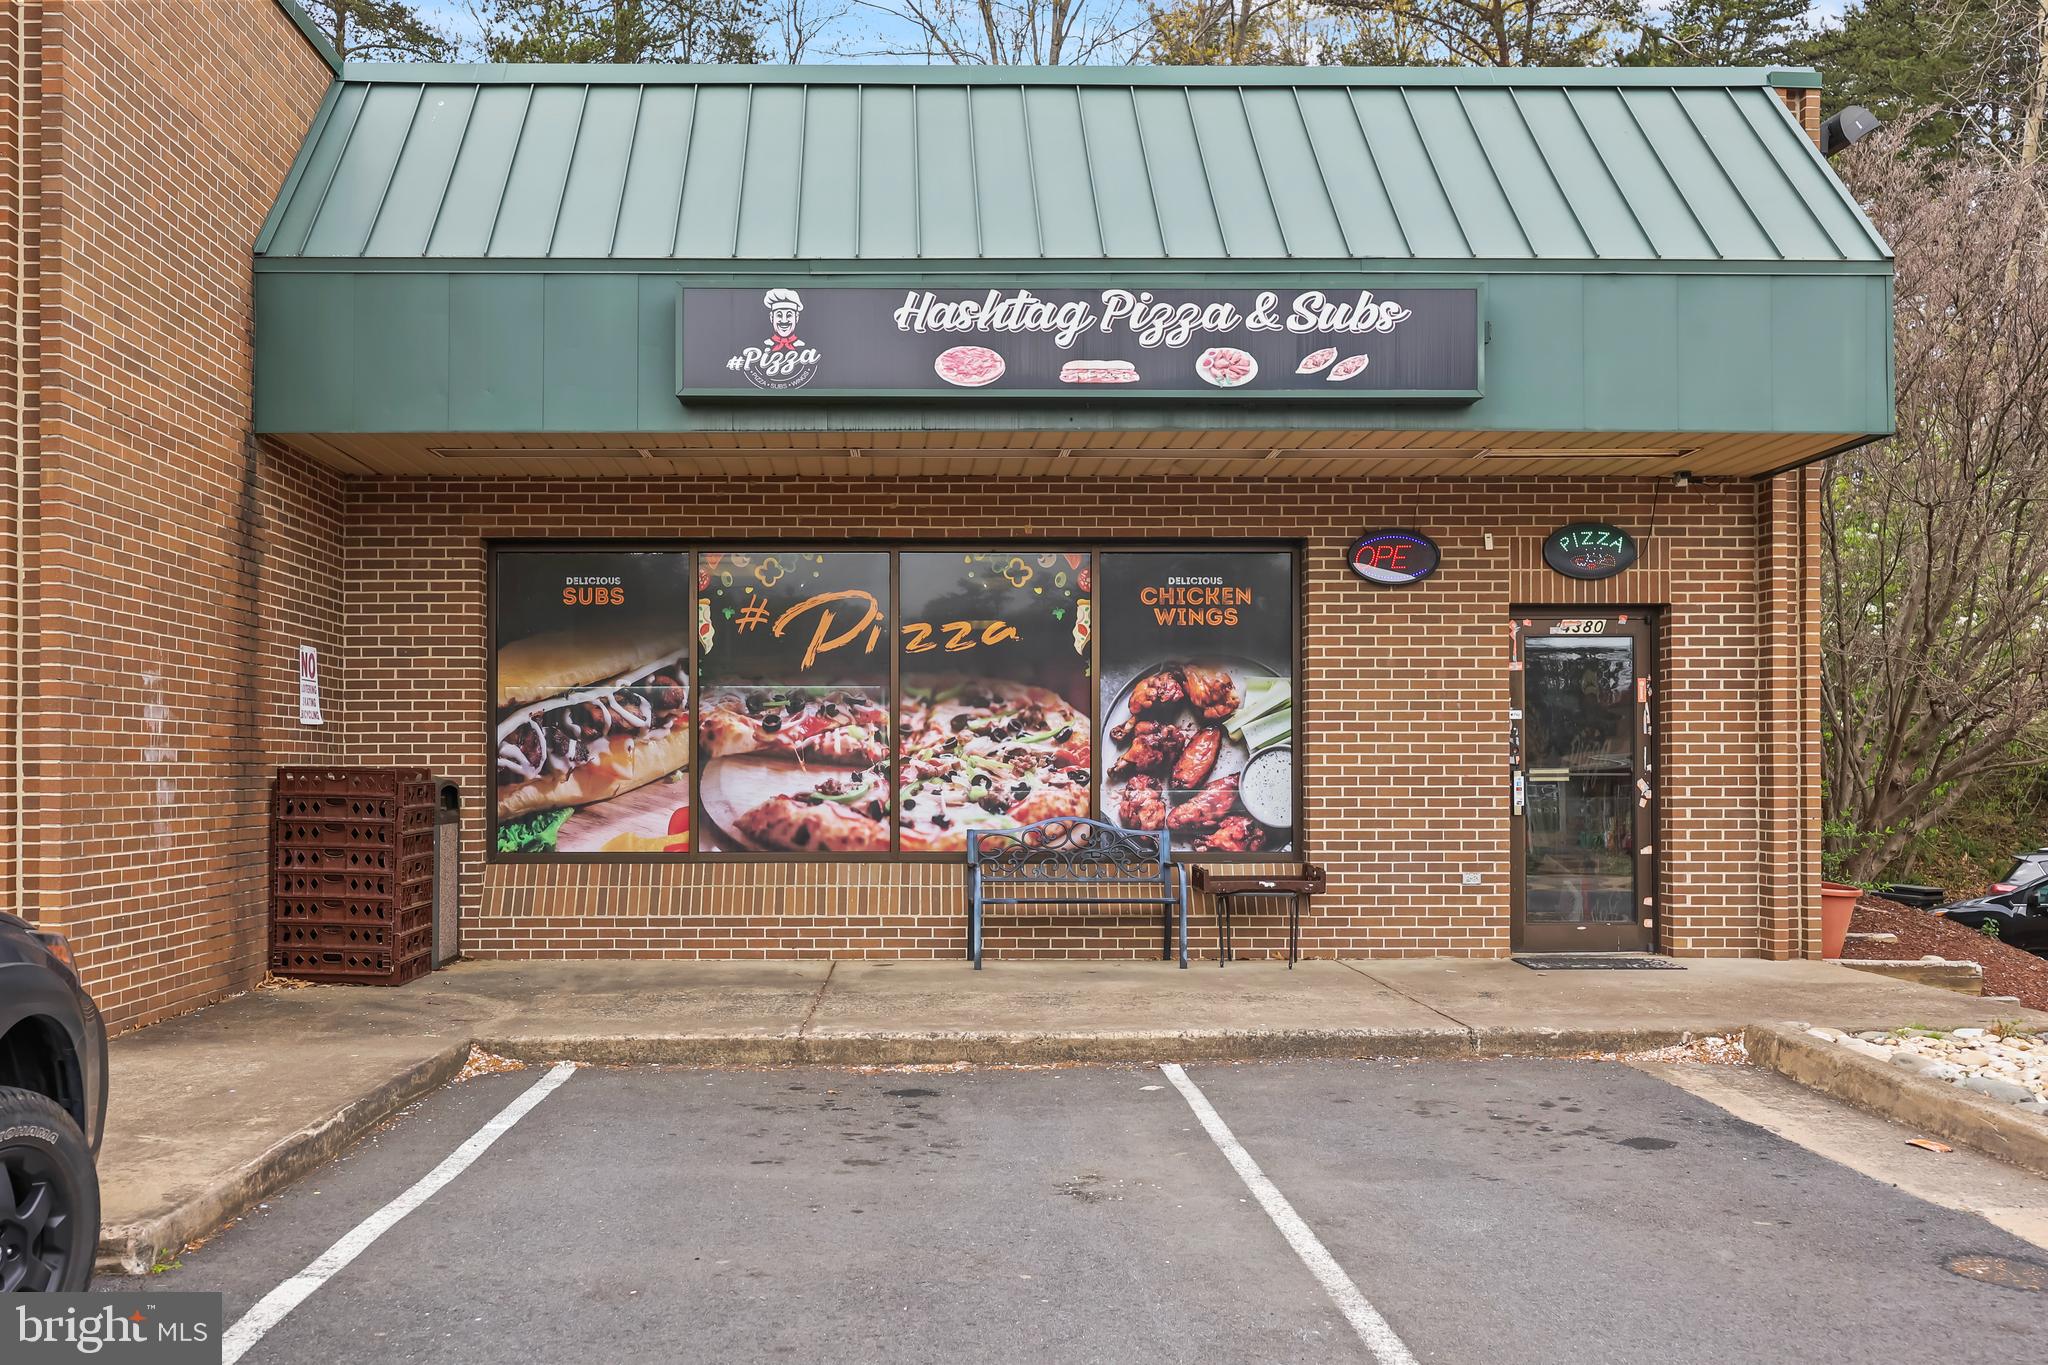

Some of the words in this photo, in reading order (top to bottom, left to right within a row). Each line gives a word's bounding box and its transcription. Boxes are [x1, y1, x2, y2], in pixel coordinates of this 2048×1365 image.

[893, 289, 1097, 349] Hashtag
[1100, 289, 1243, 349] Pizza
[1245, 291, 1283, 332] &
[1286, 290, 1412, 334] Subs
[726, 347, 821, 377] #Pizza
[1560, 531, 1623, 553] PIZZA
[566, 576, 621, 585] DELICIOUS
[1168, 576, 1223, 585] DELICIOUS
[562, 586, 625, 606] SUBS
[1140, 586, 1252, 606] CHICKEN
[1153, 607, 1239, 626] WINGS
[301, 652, 316, 679] NO
